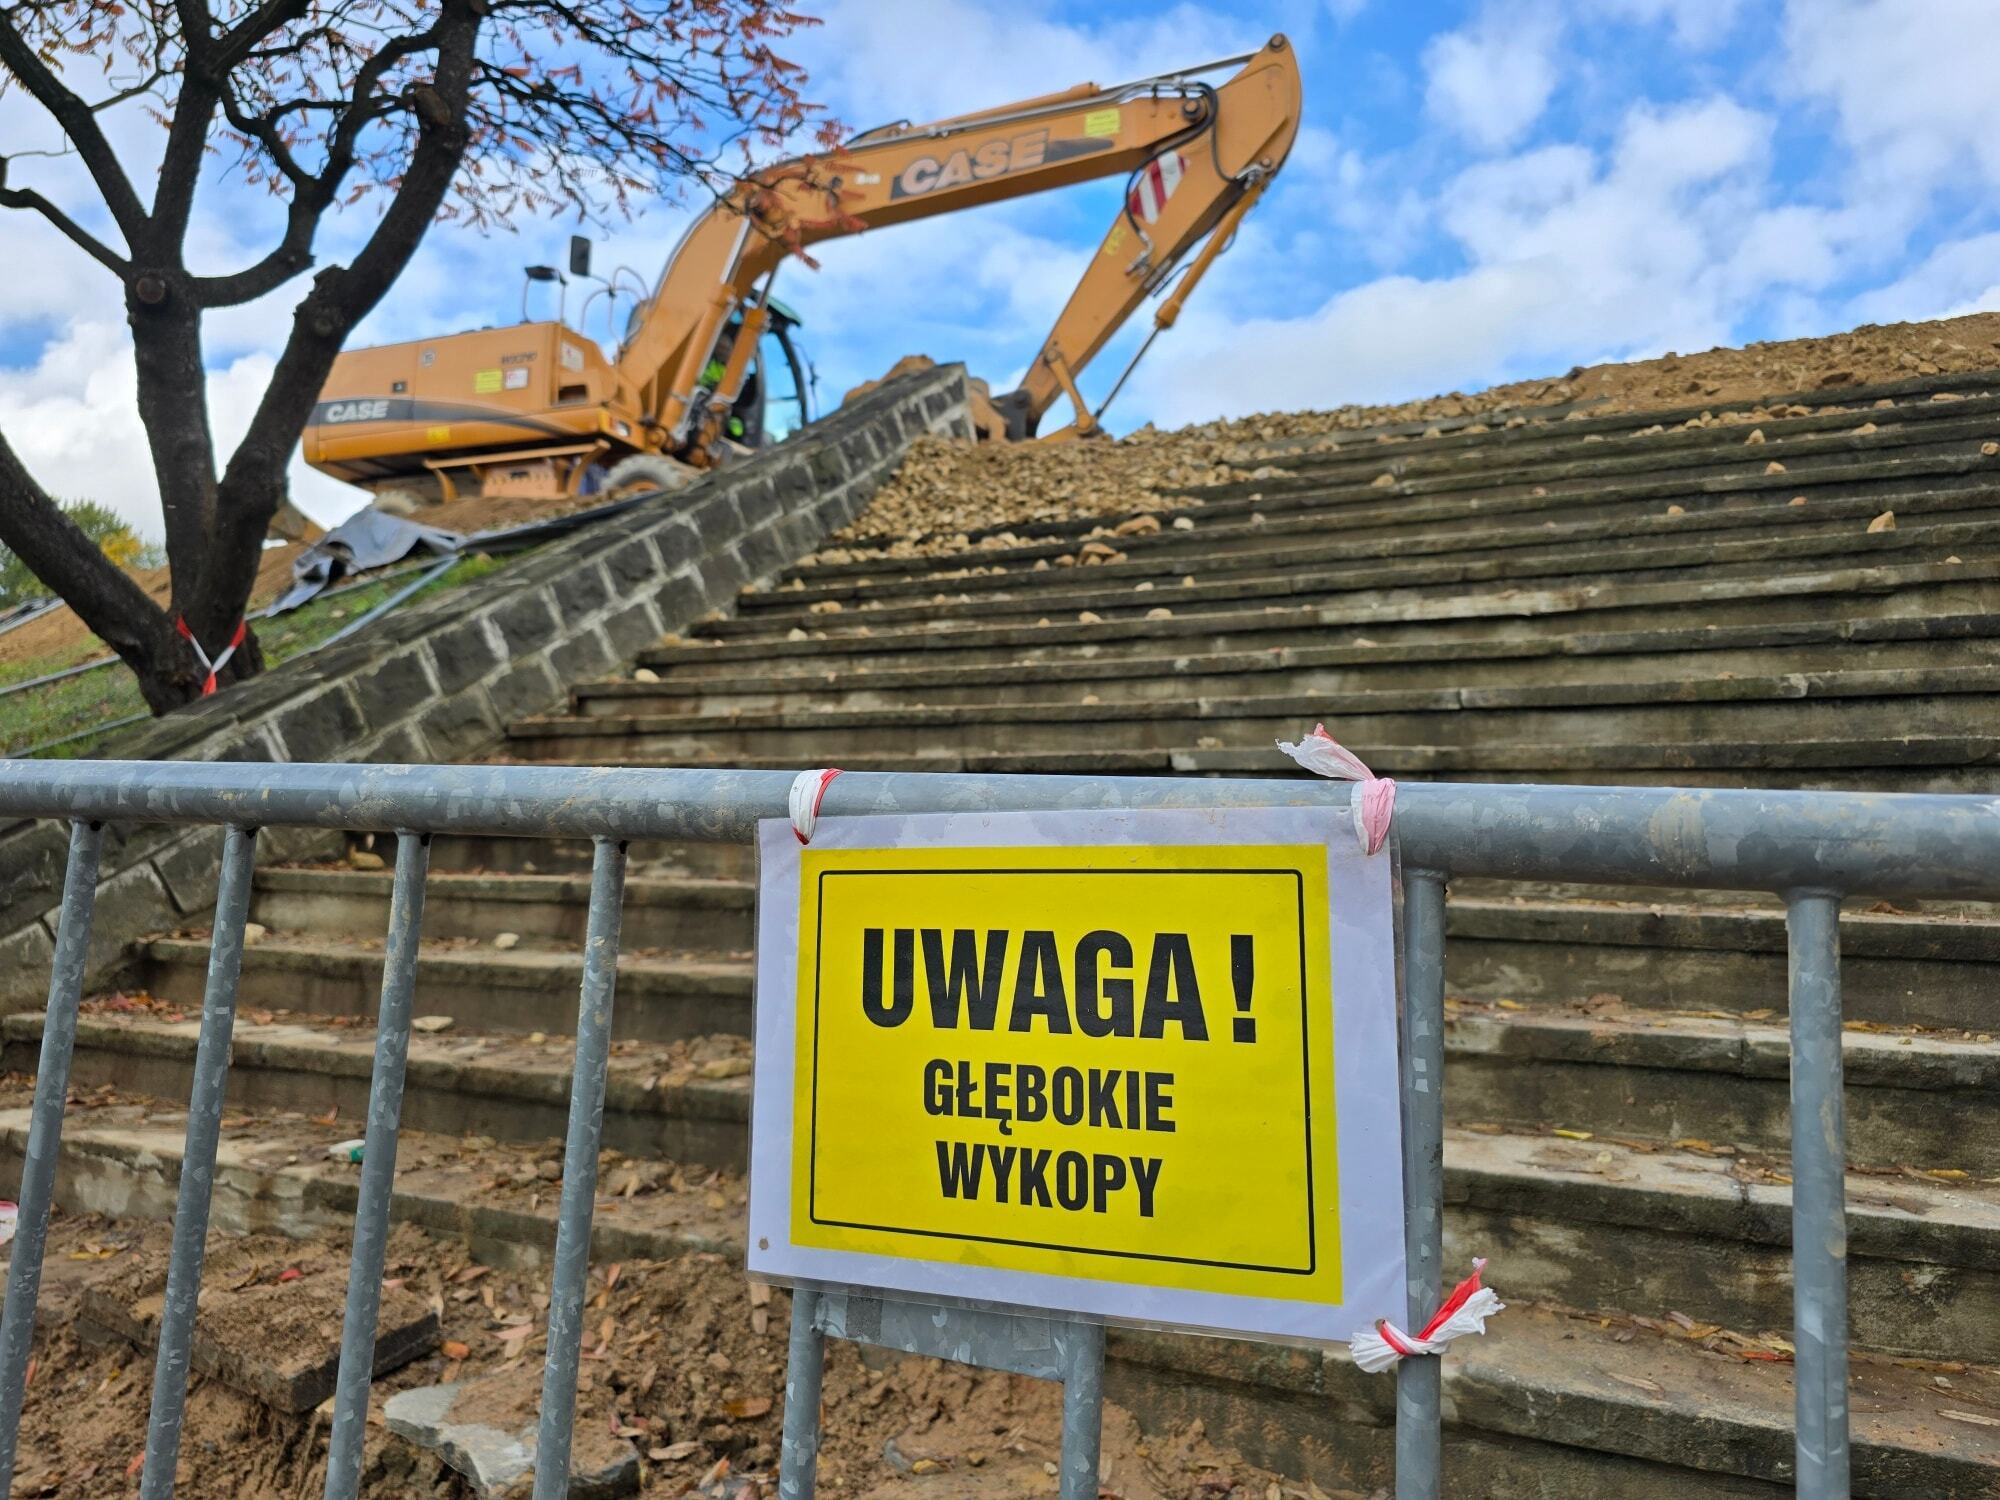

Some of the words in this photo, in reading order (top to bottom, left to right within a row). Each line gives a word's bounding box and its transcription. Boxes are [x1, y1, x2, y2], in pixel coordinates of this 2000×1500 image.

[902, 131, 1047, 195] CASE
[326, 400, 389, 423] CASE
[923, 1058, 1176, 1135] GŁĘBOKIE
[935, 1140, 1163, 1218] WYKOPY
